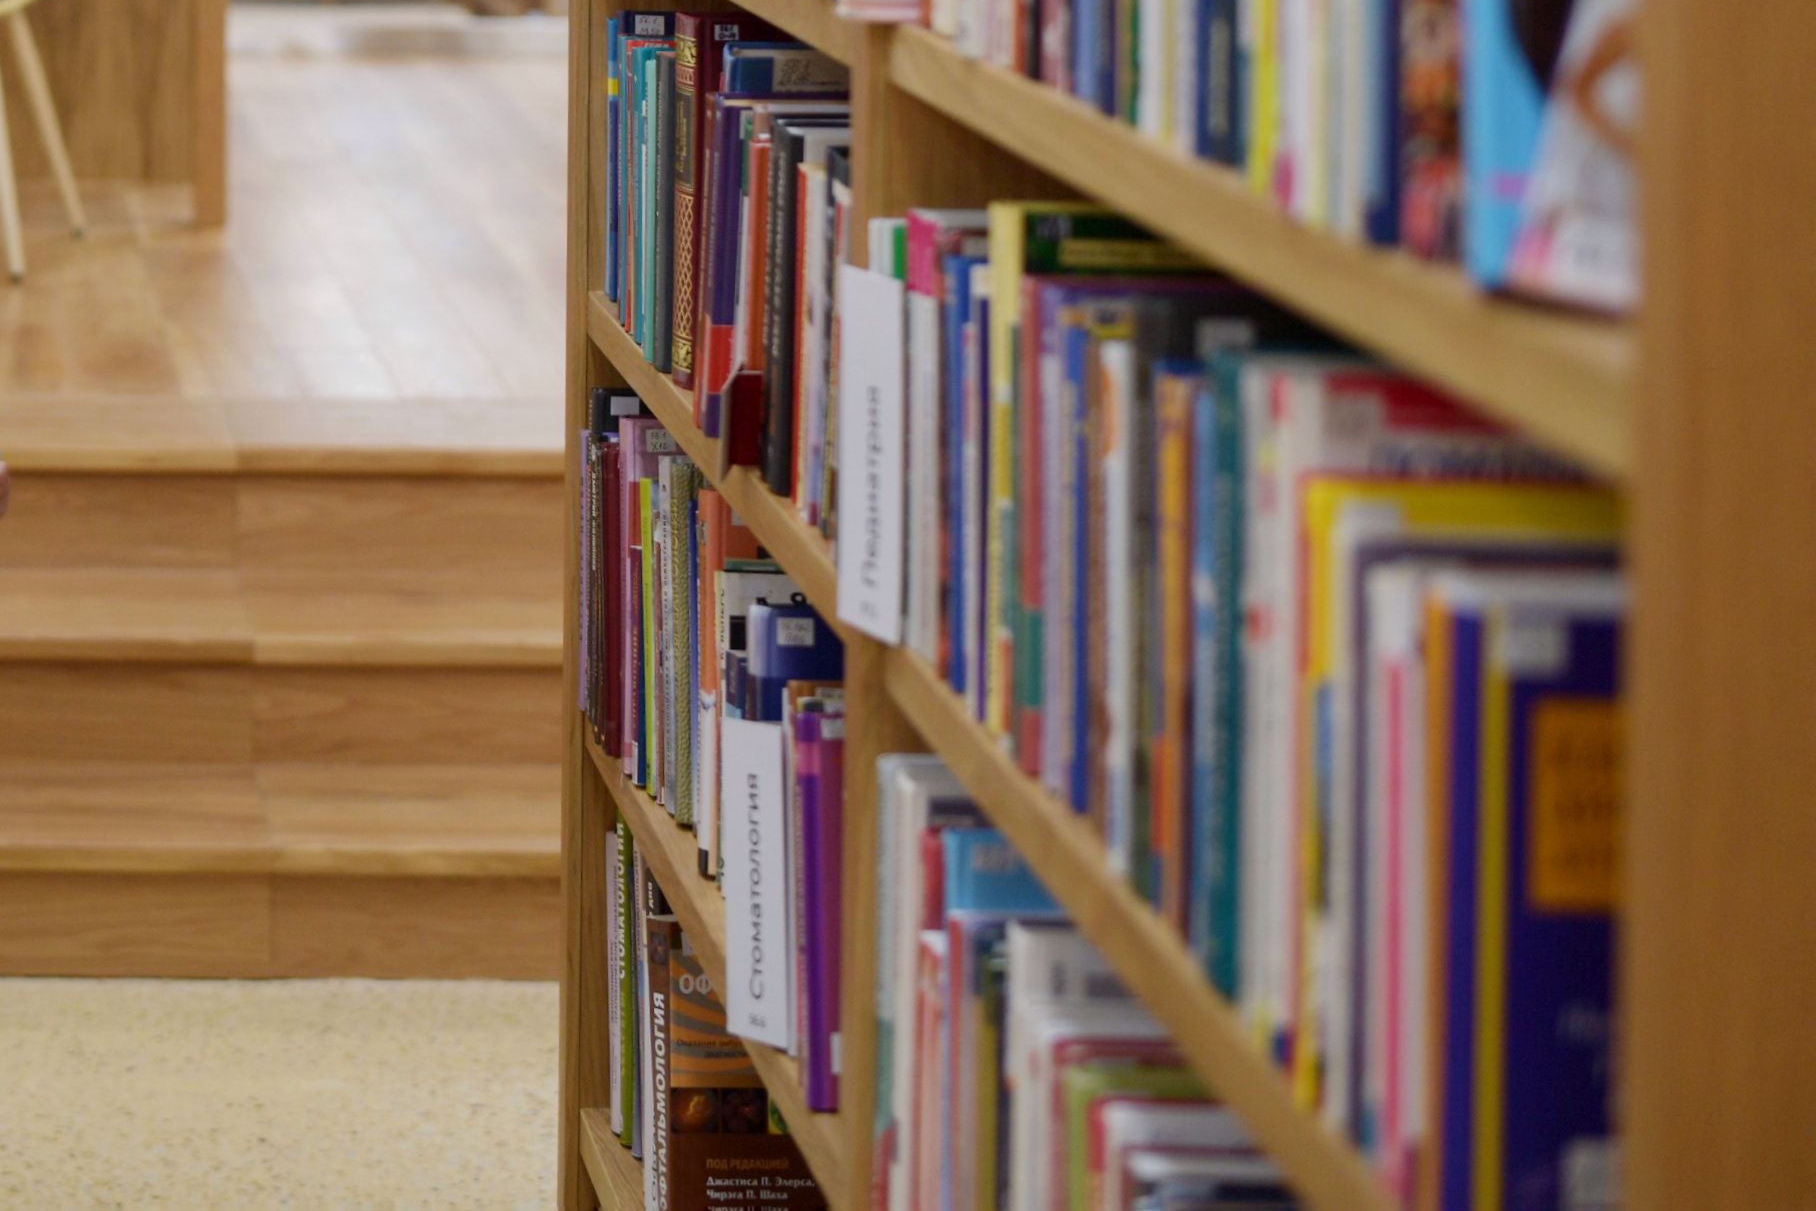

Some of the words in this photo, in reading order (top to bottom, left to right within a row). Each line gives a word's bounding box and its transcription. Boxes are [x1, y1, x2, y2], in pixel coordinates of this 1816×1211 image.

[860, 385, 882, 587] Педиатрия
[616, 822, 626, 980] СТОМАТОЛОГИИ
[747, 773, 764, 1001] Стоматология
[653, 992, 667, 1211] ОФТАЛЬМОЛОГИЯ
[705, 1176, 758, 1187] Джастиса
[760, 1176, 773, 1187] П.
[745, 1189, 757, 1199] П.
[759, 1188, 789, 1199] Шаха
